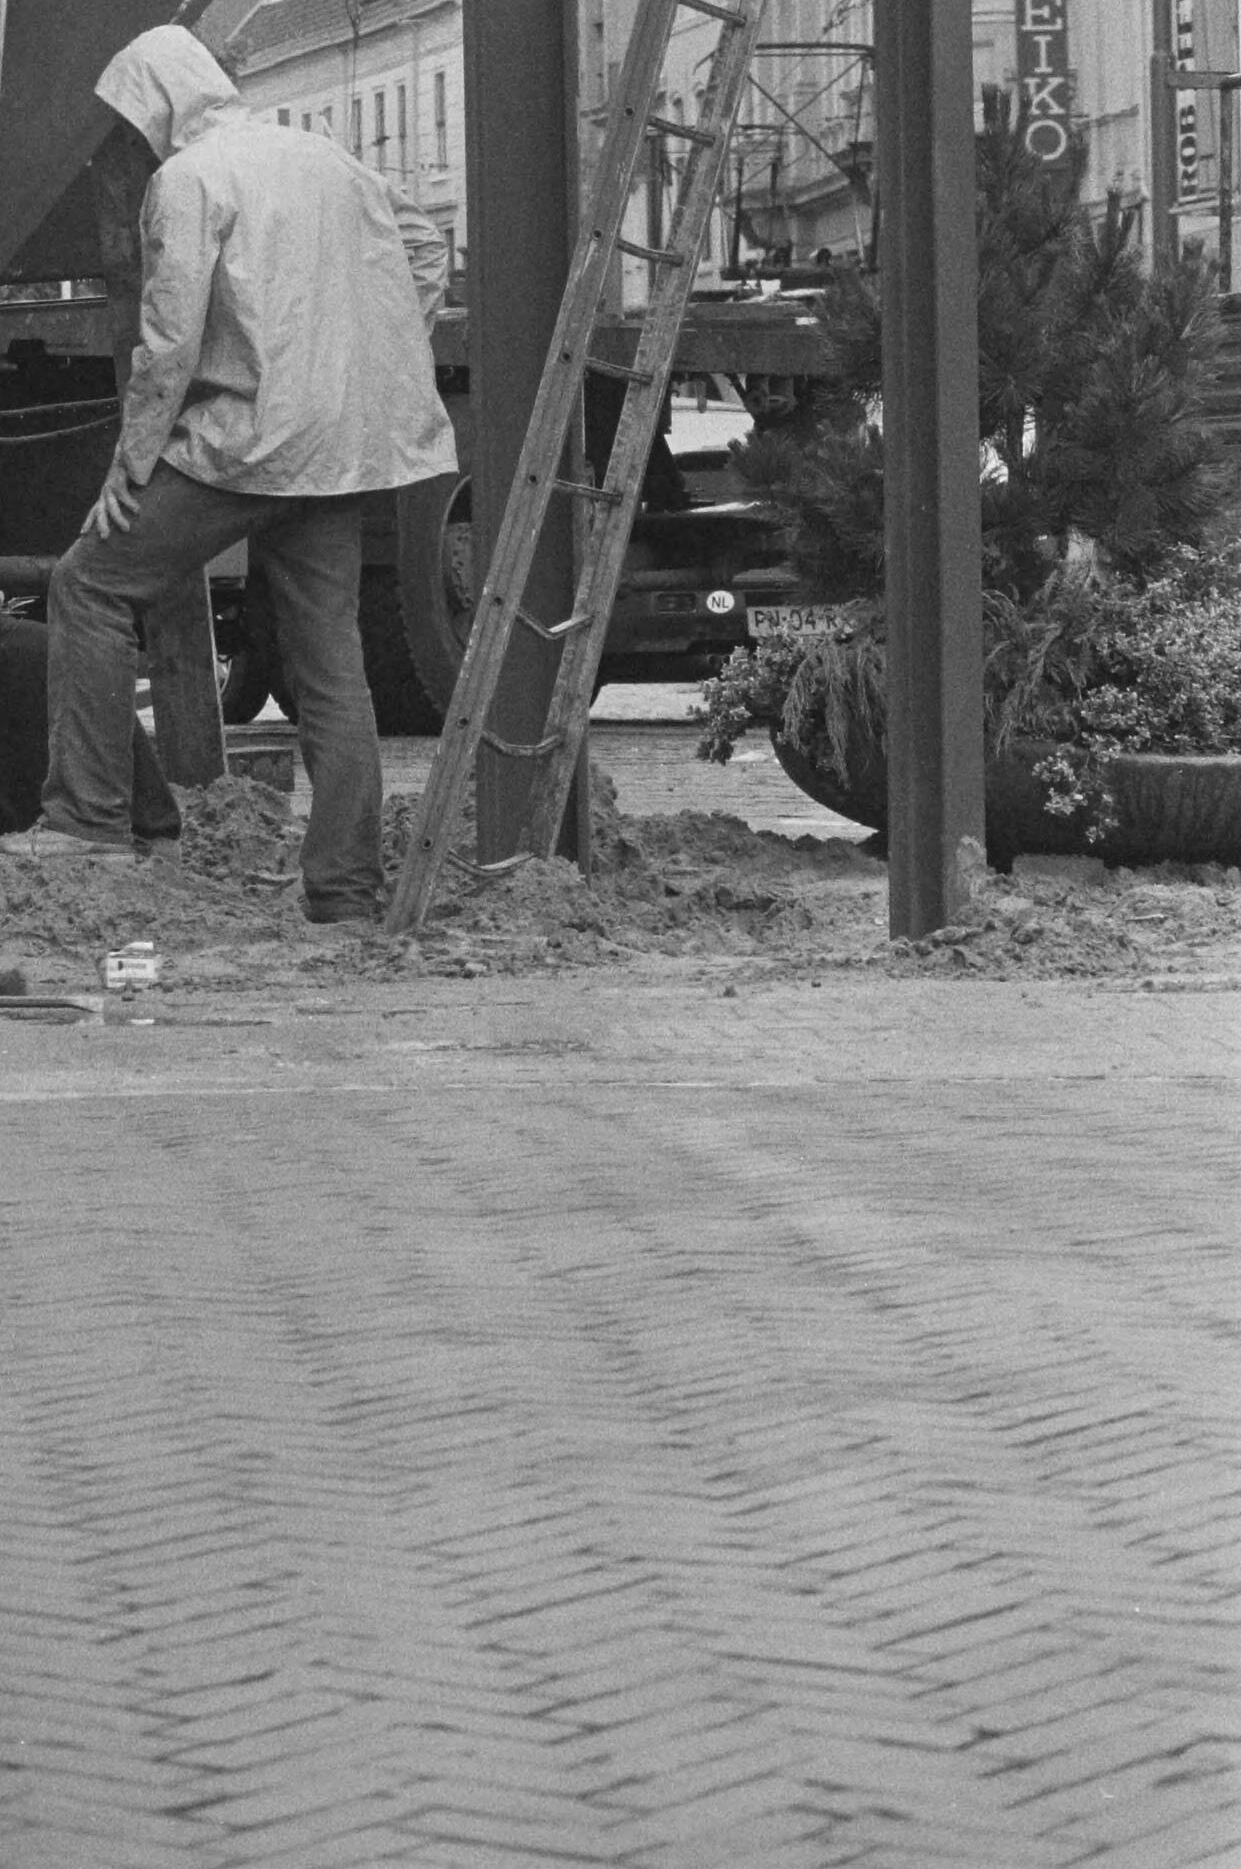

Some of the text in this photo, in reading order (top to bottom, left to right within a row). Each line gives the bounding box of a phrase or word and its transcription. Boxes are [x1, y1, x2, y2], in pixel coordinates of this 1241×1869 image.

[1179, 105, 1196, 196] ROB
[711, 596, 729, 609] NL
[754, 609, 843, 632] PN-04-R
